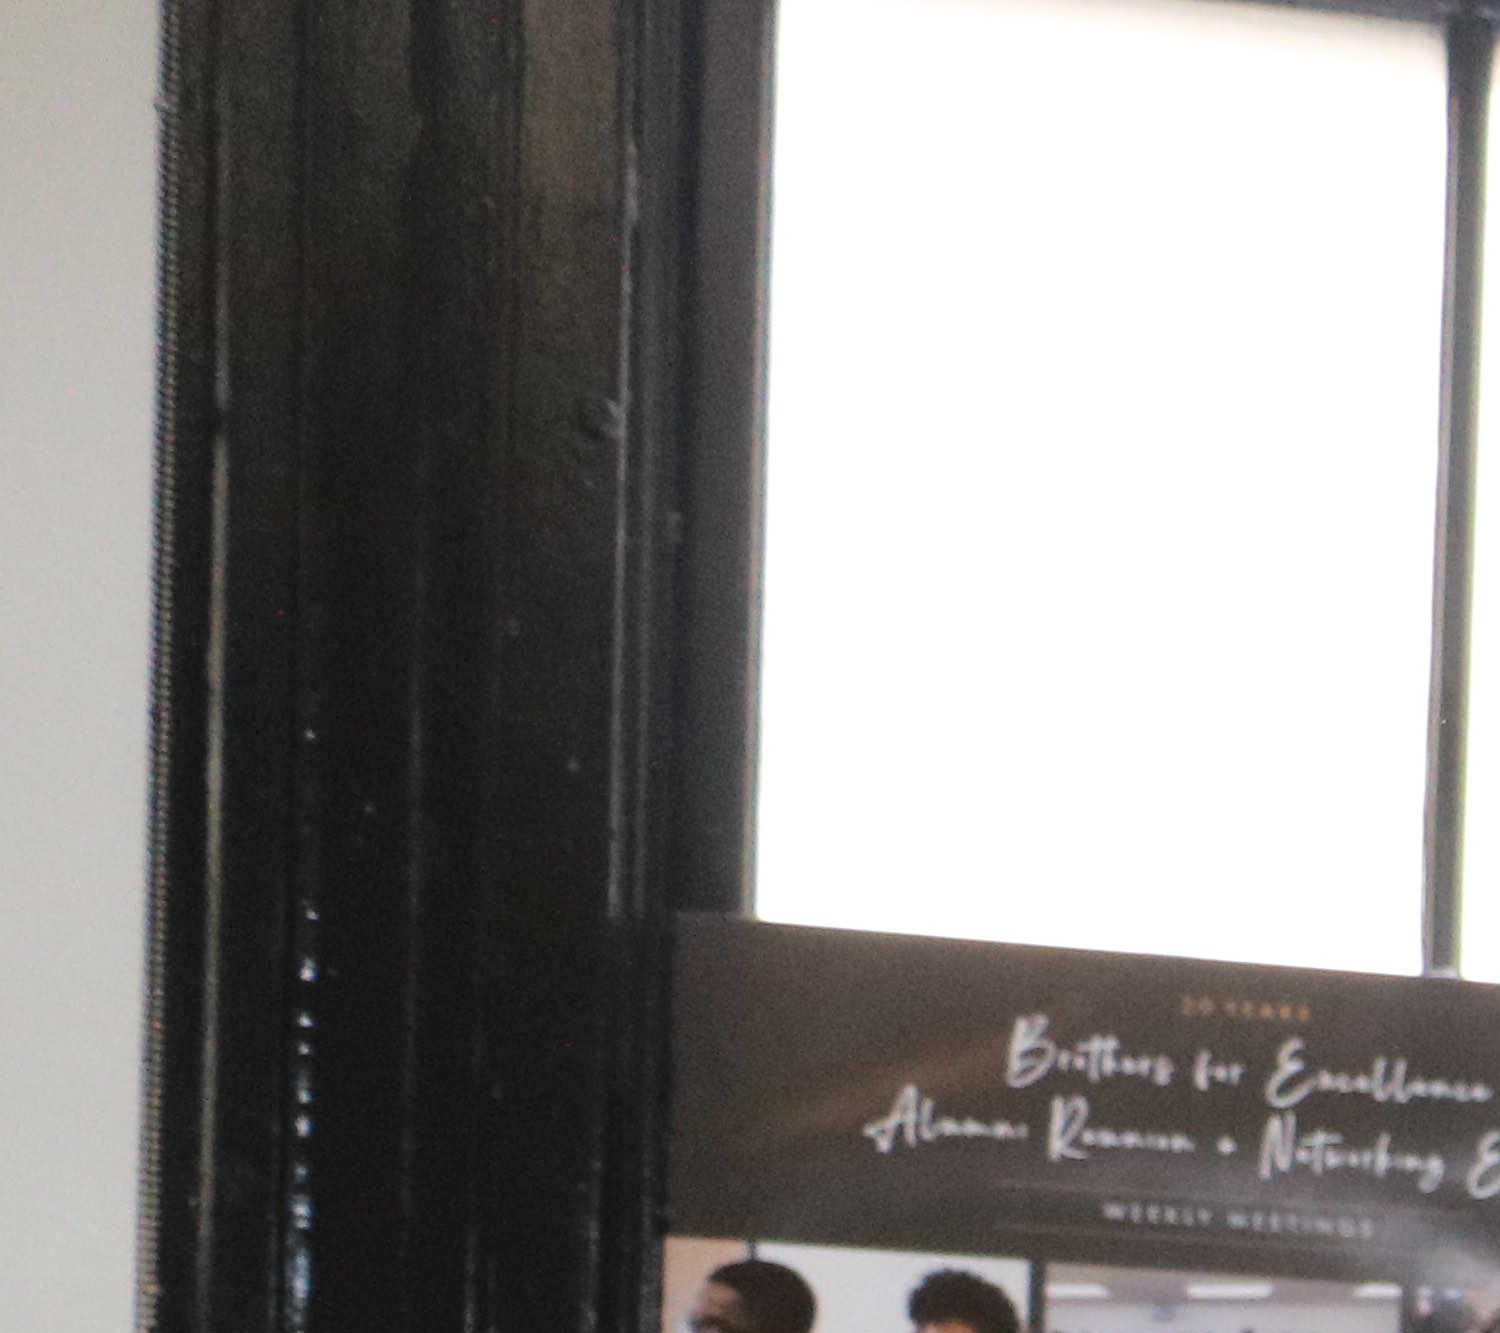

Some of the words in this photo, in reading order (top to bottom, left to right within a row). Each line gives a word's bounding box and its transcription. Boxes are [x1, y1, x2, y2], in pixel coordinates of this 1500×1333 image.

[1006, 1013, 1172, 1088] Brothers
[1194, 1049, 1246, 1091] for
[1265, 1038, 1494, 1109] Excellence
[863, 1083, 1029, 1155] Alumni
[1257, 1115, 1446, 1193] Networking
[1102, 1202, 1214, 1228] WEEKLY
[1225, 1210, 1377, 1240] MEETINGS
